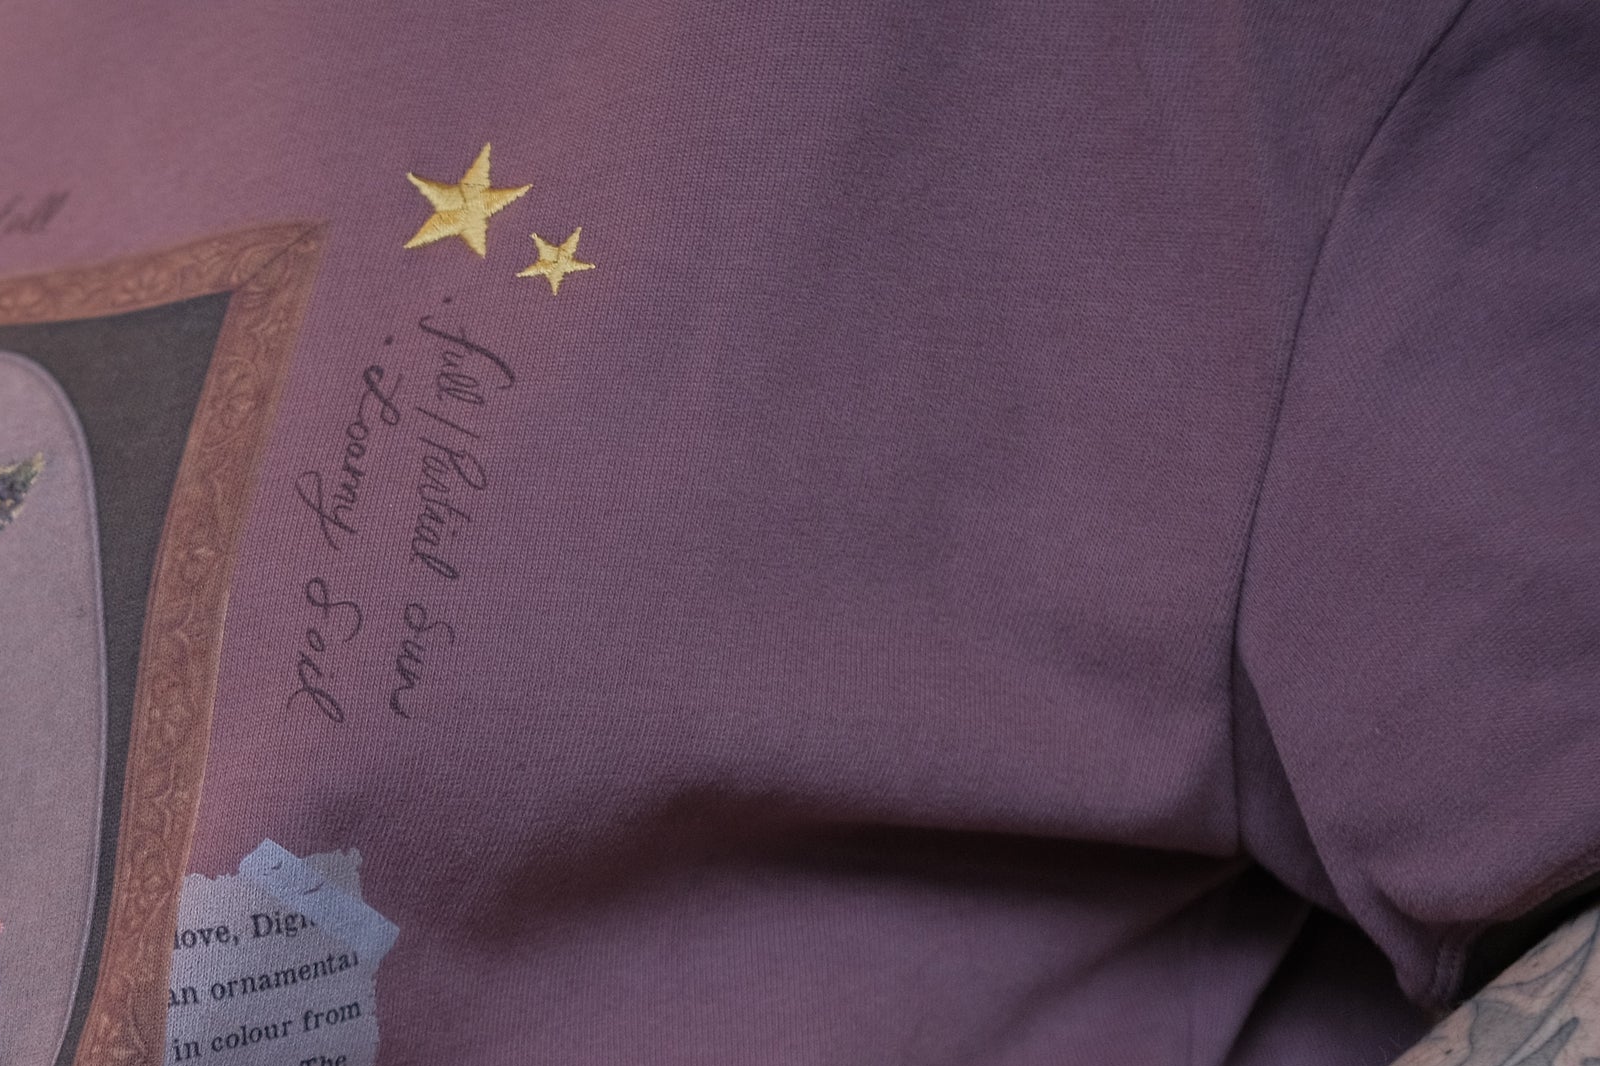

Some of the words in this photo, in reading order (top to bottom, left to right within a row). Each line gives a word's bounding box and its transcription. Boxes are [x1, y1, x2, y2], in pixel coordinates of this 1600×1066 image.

[211, 951, 360, 1001] ornamental
[172, 1038, 201, 1062] in
[211, 1019, 293, 1052] colour
[302, 1001, 362, 1033] from
